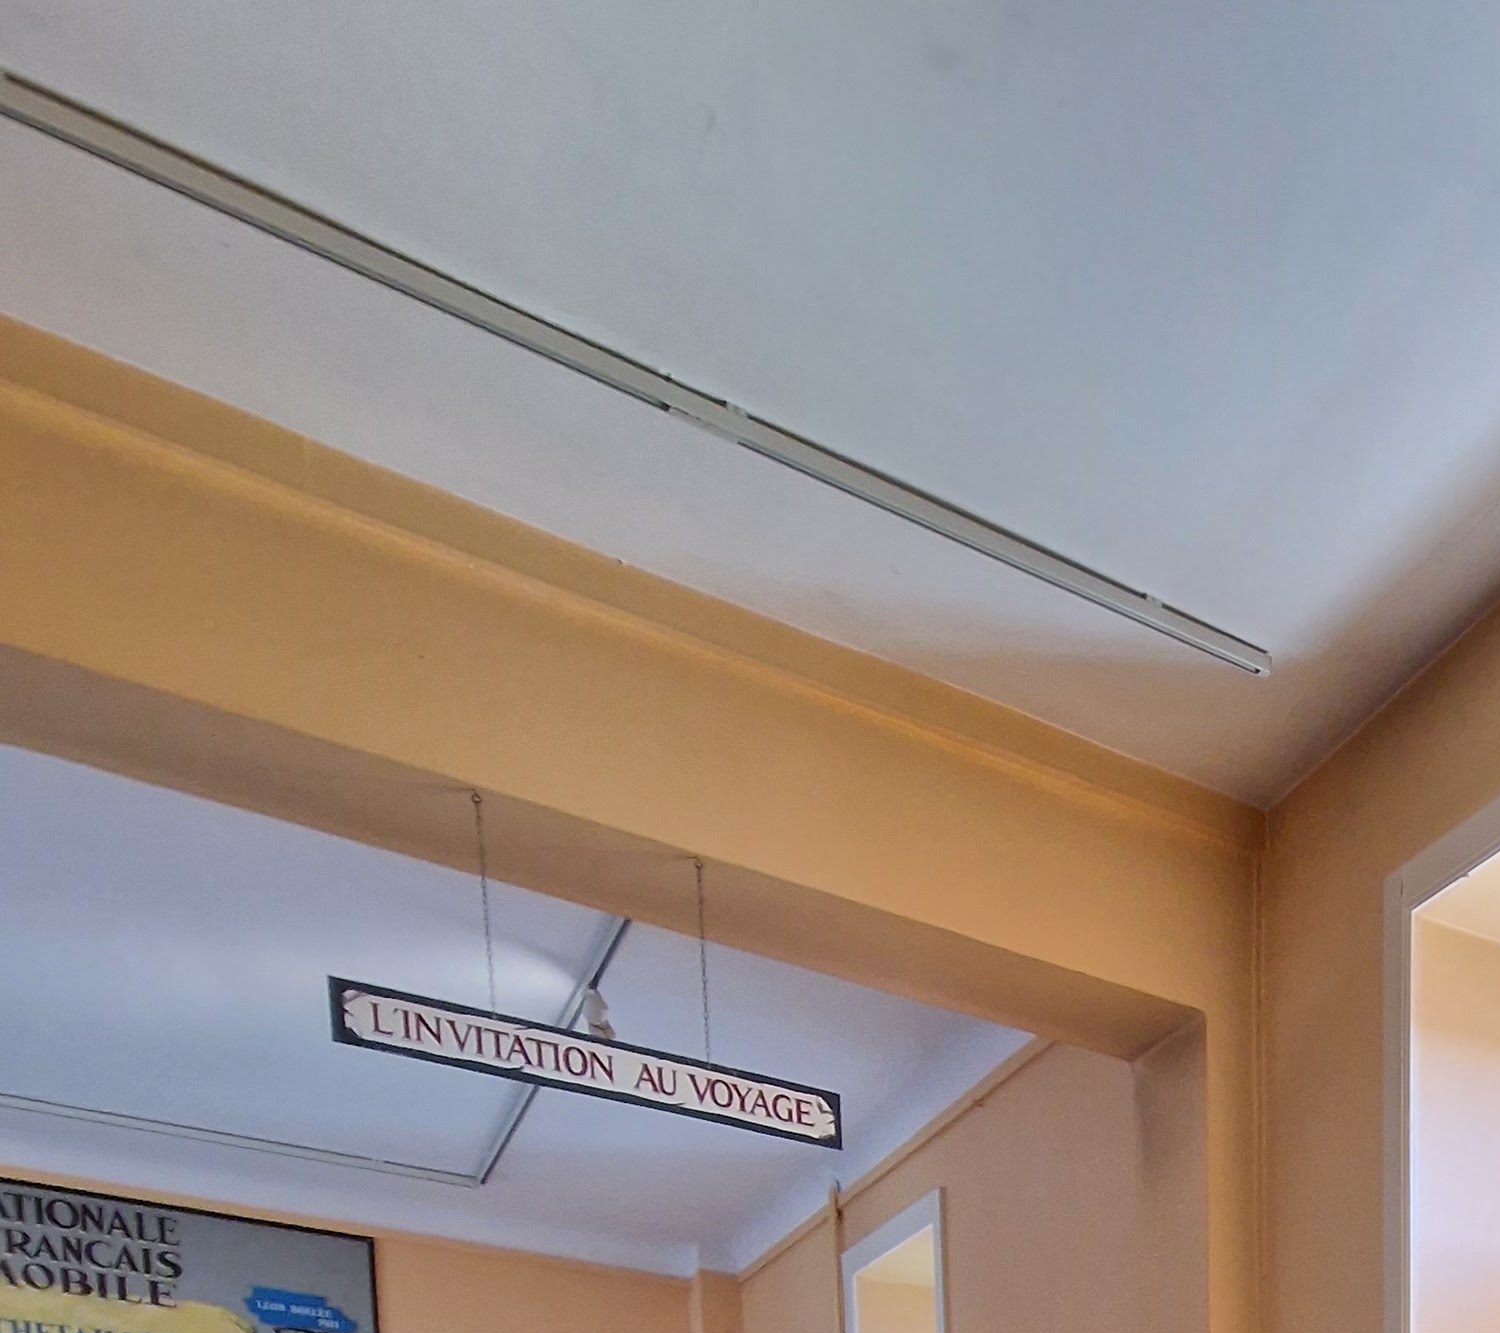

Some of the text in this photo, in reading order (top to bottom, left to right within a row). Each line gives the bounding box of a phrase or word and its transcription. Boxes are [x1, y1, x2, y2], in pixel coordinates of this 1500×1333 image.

[369, 1001, 816, 1127] L'INVITATION AU VOYAGE
